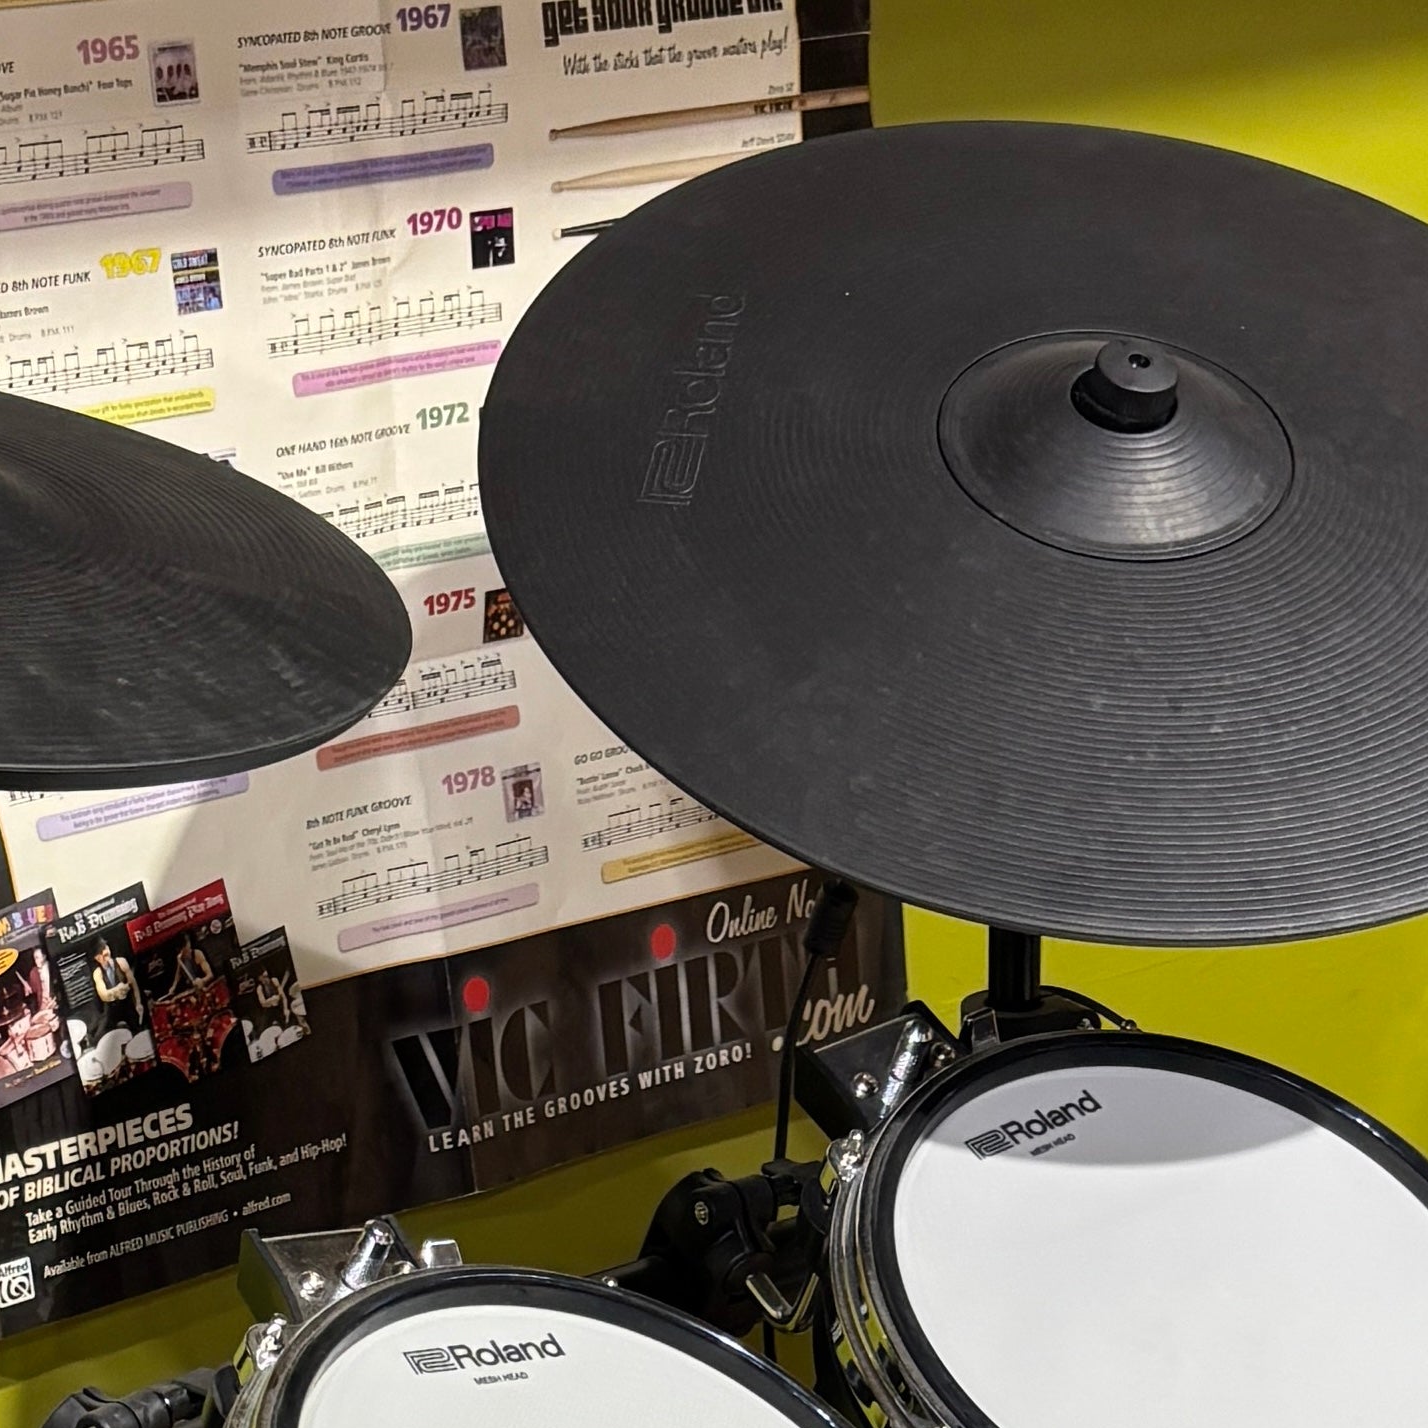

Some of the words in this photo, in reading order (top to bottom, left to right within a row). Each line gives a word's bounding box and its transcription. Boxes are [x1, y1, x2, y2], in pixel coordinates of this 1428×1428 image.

[396, 3, 451, 32] 1967
[77, 35, 140, 66] 1965
[238, 32, 301, 48] SYNCOPATED
[322, 27, 348, 40] NOTE
[351, 23, 391, 37] GROOVE
[563, 54, 590, 75] With
[592, 51, 610, 72] the
[613, 51, 640, 70] sticks
[644, 46, 664, 66] that
[667, 45, 684, 64] the
[407, 207, 462, 236] 1970
[258, 238, 325, 258] SYNCOPATED
[347, 233, 370, 247] NOTE
[100, 248, 162, 280] 1967
[11, 279, 28, 292] 8th
[31, 275, 60, 289] NOTE
[63, 271, 91, 285] FUNK
[416, 402, 470, 430] 1972
[276, 444, 296, 458] ONE
[298, 441, 327, 454] HAND
[351, 431, 373, 445] NOTE
[424, 587, 476, 617] 1975
[442, 765, 496, 796] 1978
[322, 808, 345, 825] NOTE
[371, 795, 412, 815] GROOVE
[706, 895, 778, 944] Online
[429, 1122, 495, 1153] LEARN
[501, 1107, 536, 1134] THE
[544, 1077, 630, 1119] GROOVES
[638, 1060, 686, 1092] WITH
[694, 1042, 754, 1076] ZORO!
[1004, 1090, 1102, 1144] Roland
[24, 1165, 105, 1202] BIBLICAL
[110, 1121, 239, 1177] PROPORTIONS!
[26, 1208, 52, 1228] Take
[55, 1207, 64, 1220] a
[65, 1190, 106, 1215] Guided
[108, 1184, 132, 1203] Tour
[134, 1169, 180, 1196] Through
[182, 1164, 201, 1181] the
[203, 1152, 241, 1178] History
[243, 1144, 256, 1162] of
[28, 1223, 57, 1246] Early
[60, 1209, 104, 1237] Rhythm
[106, 1206, 115, 1220] &
[118, 1195, 151, 1218] Blues,
[153, 1187, 179, 1206] Rock
[182, 1184, 191, 1197] &
[280, 1149, 299, 1167] and
[300, 1132, 347, 1162] Hip-Hop!
[44, 1253, 85, 1280] Available
[86, 1246, 109, 1265] from
[110, 1237, 143, 1260] ALFRED
[145, 1227, 174, 1249] MUSIC
[176, 1208, 229, 1238] PUBLISHING
[242, 1191, 291, 1218] alfred.com
[453, 1333, 566, 1369] Roland
[473, 1374, 501, 1386] MESH
[502, 1371, 529, 1384] HEAD
